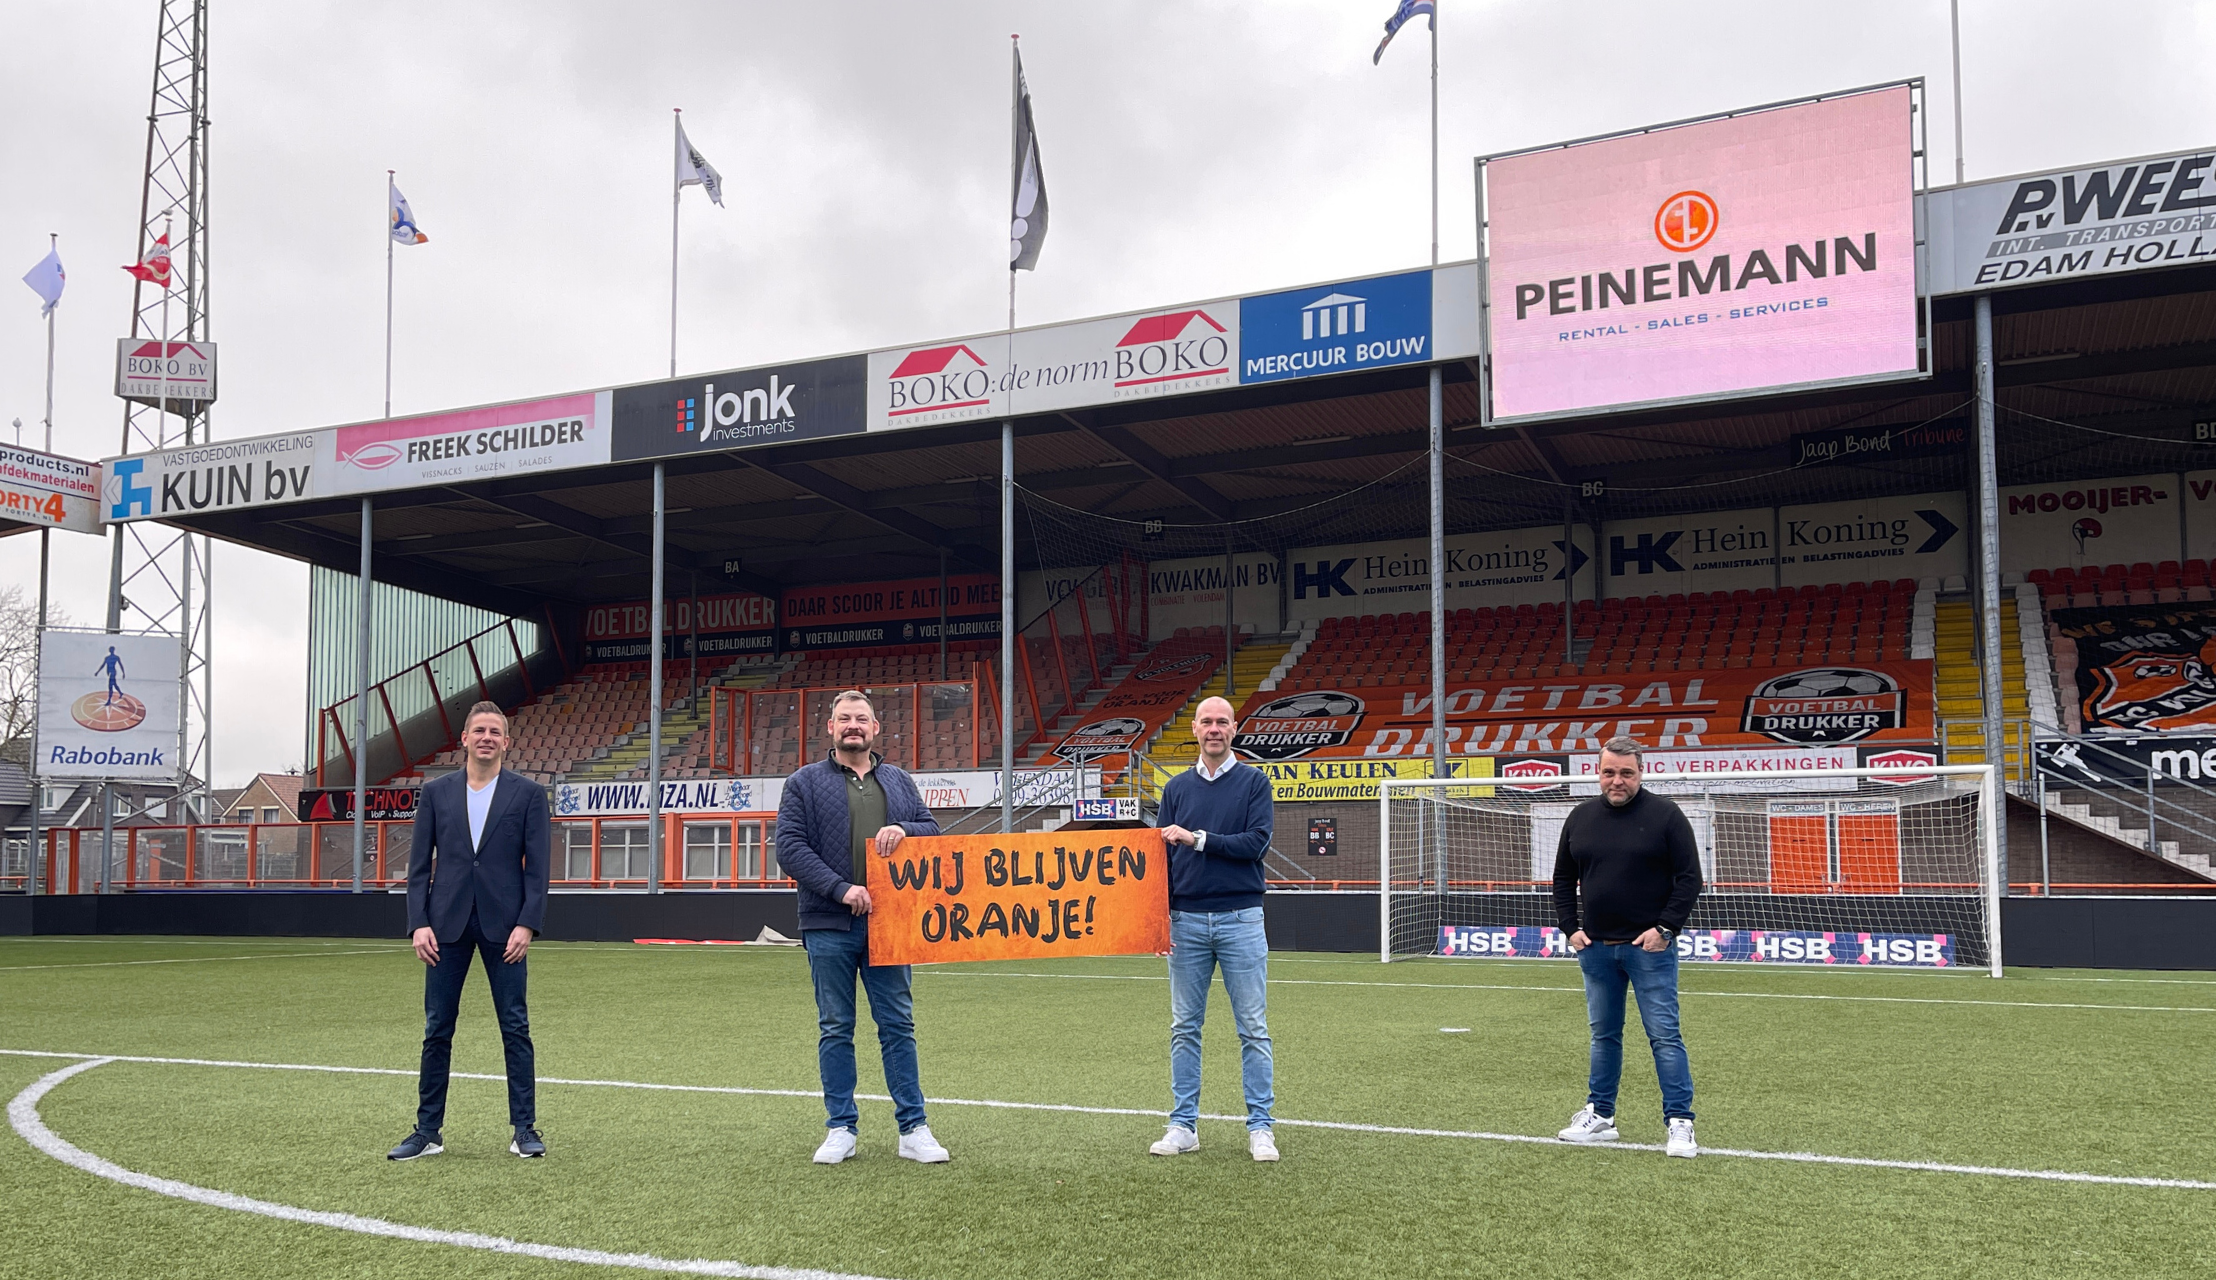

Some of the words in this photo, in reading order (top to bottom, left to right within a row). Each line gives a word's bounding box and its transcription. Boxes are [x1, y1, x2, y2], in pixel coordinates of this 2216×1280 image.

[2062, 156, 2216, 226] WEE
[1996, 237, 2045, 256] INT.
[1516, 232, 1877, 321] PEINEMANN
[1974, 250, 2094, 285] EDAM
[1559, 323, 1628, 342] RENTAL
[1647, 313, 1709, 331] SALES
[1729, 297, 1829, 320] SERVICES
[128, 357, 180, 376] BOKO
[188, 362, 207, 376] BV
[999, 363, 1030, 393] de
[1036, 359, 1109, 386] norm
[1114, 335, 1229, 380] BOKO
[1247, 347, 1347, 377] MERCUUR
[1356, 335, 1426, 362] BOUW
[121, 382, 214, 398] DAKBEEKKERS
[1114, 375, 1231, 398] DAKBEDEKKERS
[700, 374, 796, 443] jonk
[888, 408, 991, 427] DAKBEDEKKERS
[713, 418, 796, 441] investments
[163, 435, 313, 468] VASTGOEDONTWIKKELING
[407, 434, 472, 464] FREEK
[476, 420, 585, 455] SCHILDER
[1796, 438, 1838, 466] Jaap
[1845, 429, 1890, 452] Bond
[1902, 426, 1966, 448] Tribune
[421, 466, 463, 479] VISSNACKS
[474, 461, 506, 473] SAUZEN
[518, 455, 553, 468] SALADES
[161, 462, 253, 512] KUIN
[265, 460, 311, 501] bv
[1610, 530, 1686, 576] HK
[1692, 524, 1769, 554] Hein
[1787, 514, 1910, 546] Koning
[724, 560, 740, 575] BA
[1692, 557, 1776, 571] ADMINISTRATIE
[1781, 555, 1796, 565] EN
[1803, 547, 1906, 563] BELASTINGADVIES
[1151, 564, 1249, 595] KWAKMAN
[1257, 561, 1281, 586] BV
[1293, 557, 1358, 600] HK
[1363, 553, 1429, 580] Hein
[1445, 544, 1549, 573] Koning
[1363, 582, 1432, 596] ADMINISTRATI
[1458, 574, 1545, 588] BELASTINGADVIES
[788, 596, 826, 618] DAAR
[832, 592, 884, 614] SCOOR
[889, 590, 905, 610] JE
[585, 603, 672, 637] OETBL
[597, 642, 667, 658] VOETBALDRUKR
[698, 635, 773, 652] VOETBALDRUKKER
[806, 628, 884, 645] VOETBALDRUKKER
[1401, 678, 1720, 717] VOETBAL
[1768, 698, 1882, 715] VOETBAL
[1254, 718, 1339, 733] VOETBAL
[1763, 714, 1880, 731] DRUKKER
[1240, 731, 1333, 747] DRUKKER
[1363, 717, 1709, 757] DRUKKER
[50, 745, 164, 766] Rabobank
[1582, 761, 1665, 775] PLIC
[1676, 756, 1844, 774] VERPAKKINGEN
[993, 771, 1074, 787] VLENDAM
[1309, 762, 1398, 780] KEULEN
[1119, 799, 1136, 808] VAK
[1277, 786, 1293, 799] en
[1080, 803, 1112, 816] HSB
[888, 849, 964, 896] WIJ
[984, 844, 1147, 891] BLIJVEN
[921, 894, 1097, 944] ORANJE!
[1448, 931, 1513, 952] HSB
[1676, 934, 1718, 957] SB
[1757, 936, 1831, 960] HSB
[1864, 938, 1942, 964] HSB
